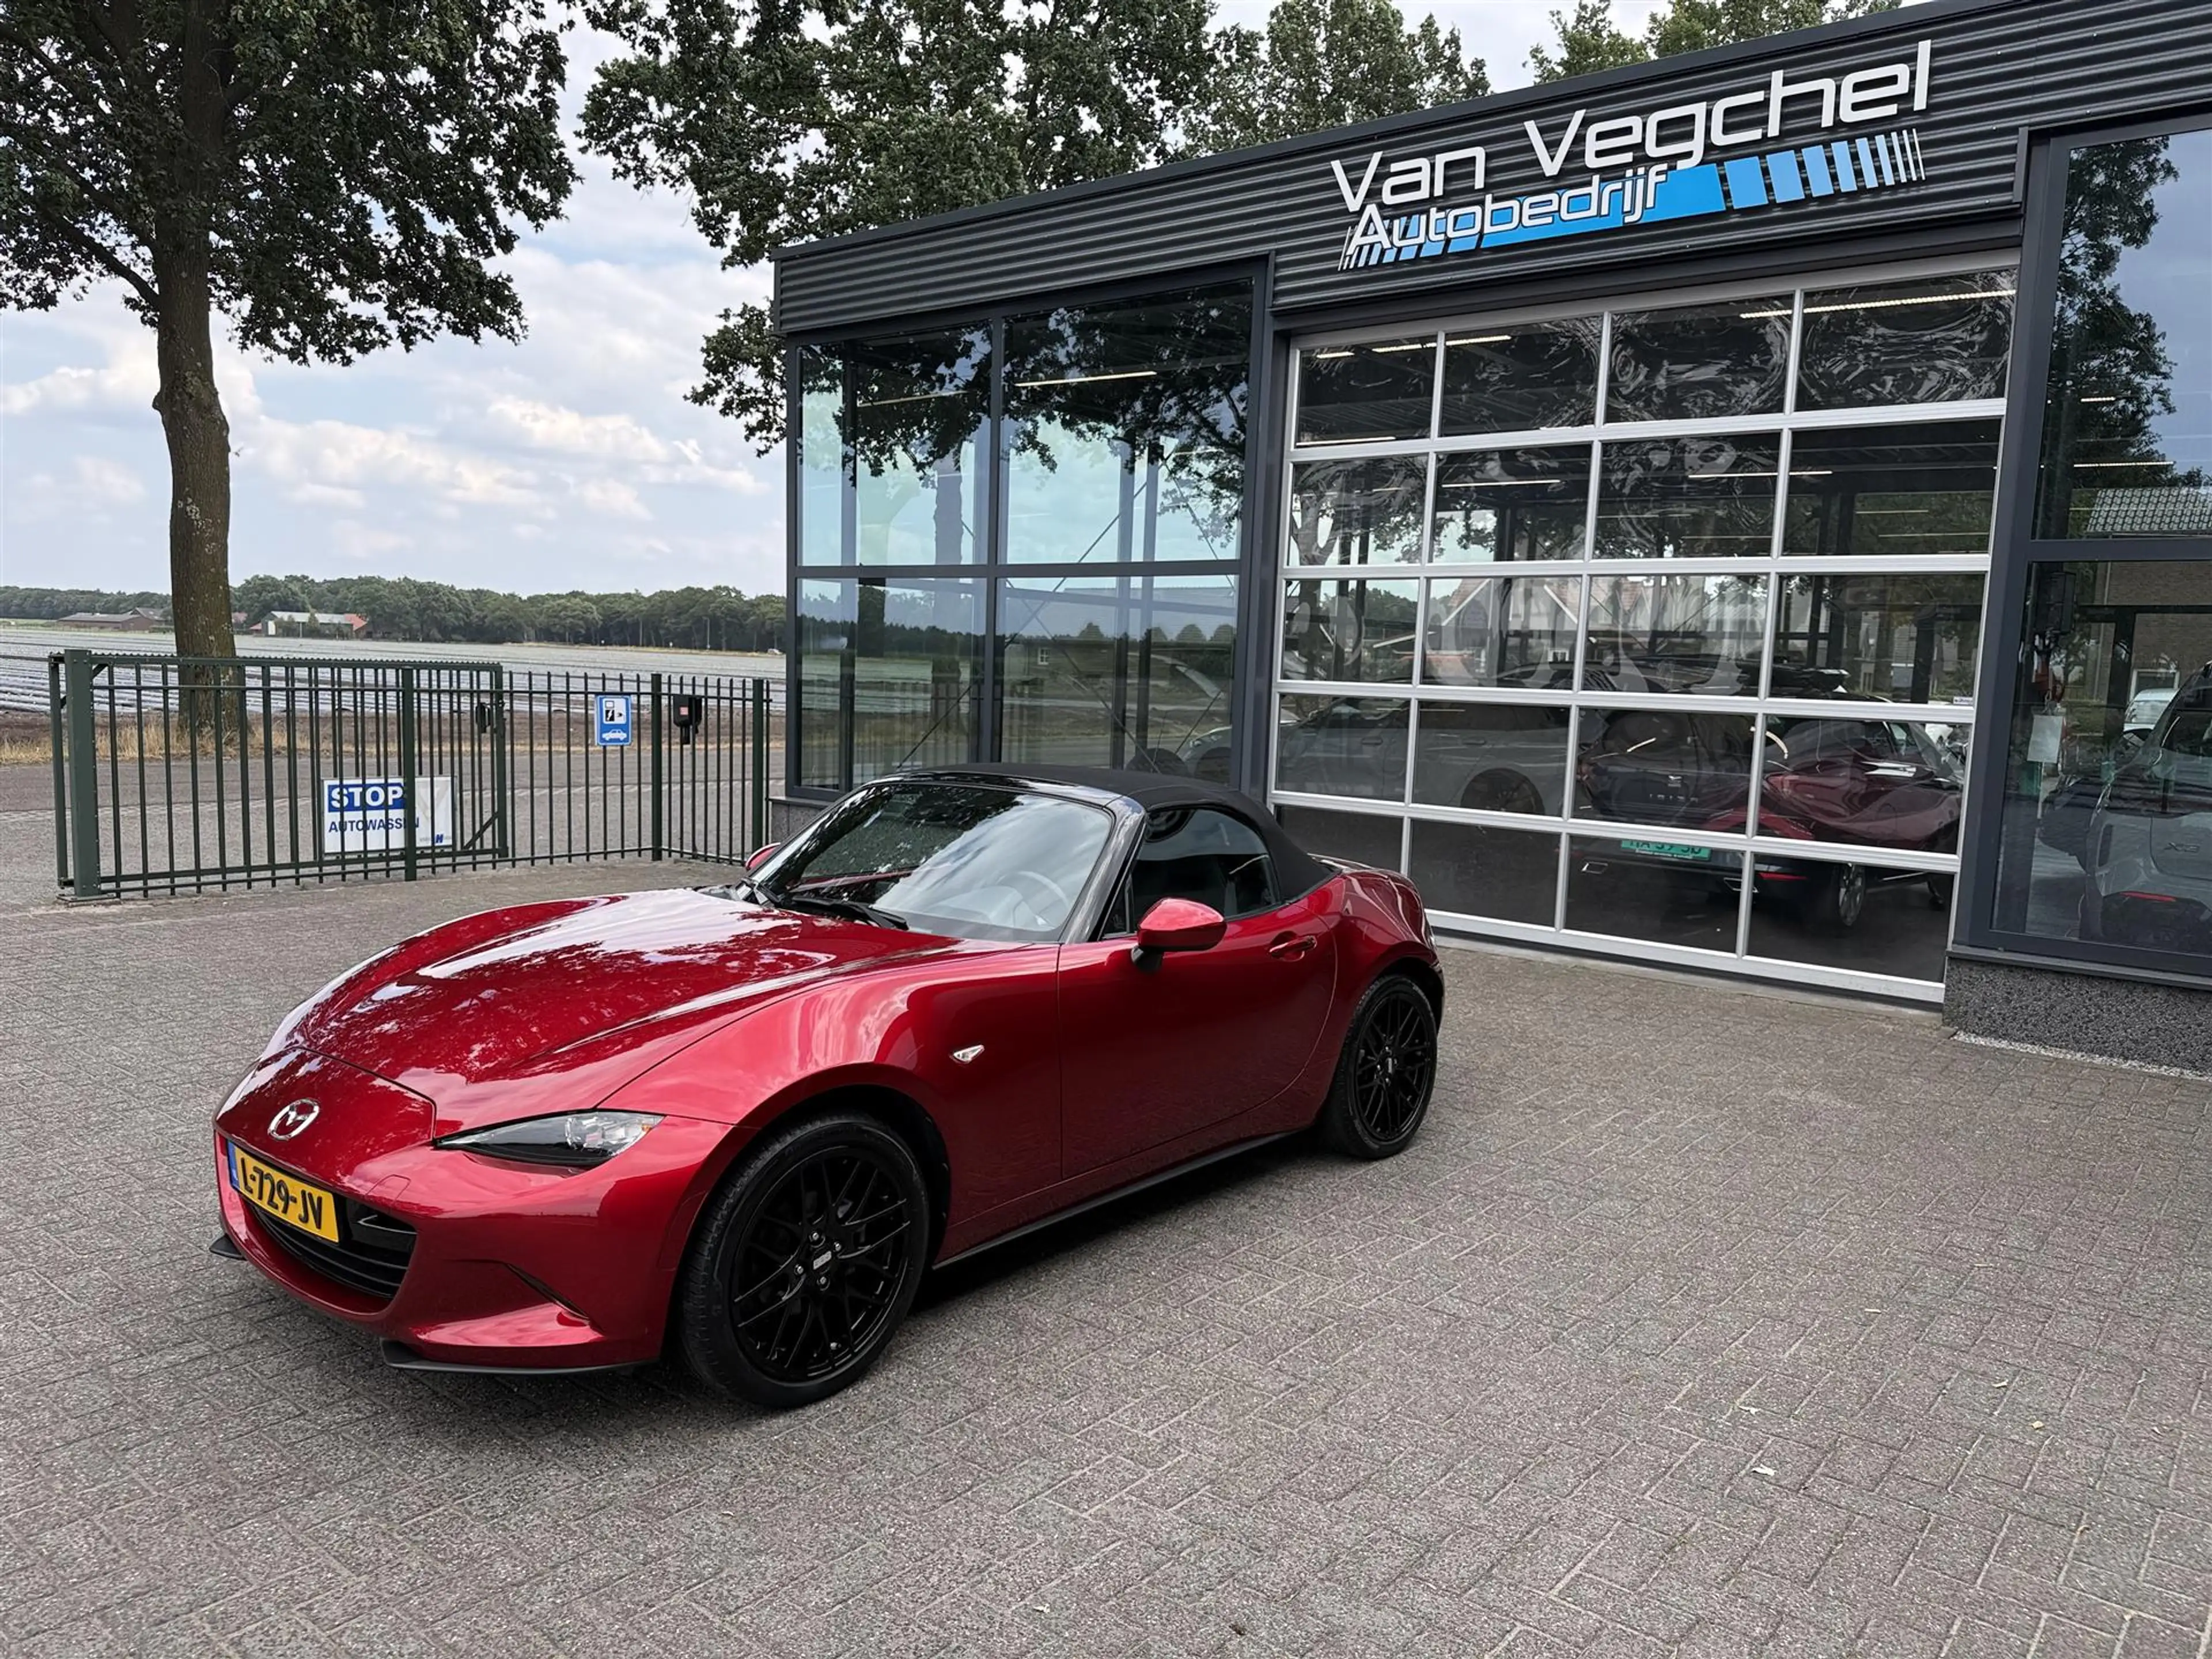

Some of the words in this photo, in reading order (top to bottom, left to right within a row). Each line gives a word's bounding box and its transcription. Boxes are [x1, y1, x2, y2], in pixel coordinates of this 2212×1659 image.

[1331, 151, 1486, 213] Van
[1524, 39, 1932, 177] Vegchel
[1345, 162, 1668, 256] Autobedrijf
[328, 816, 419, 833] AUTOWASSN
[330, 785, 404, 809] STOP
[240, 1157, 323, 1230] L-729-JV
